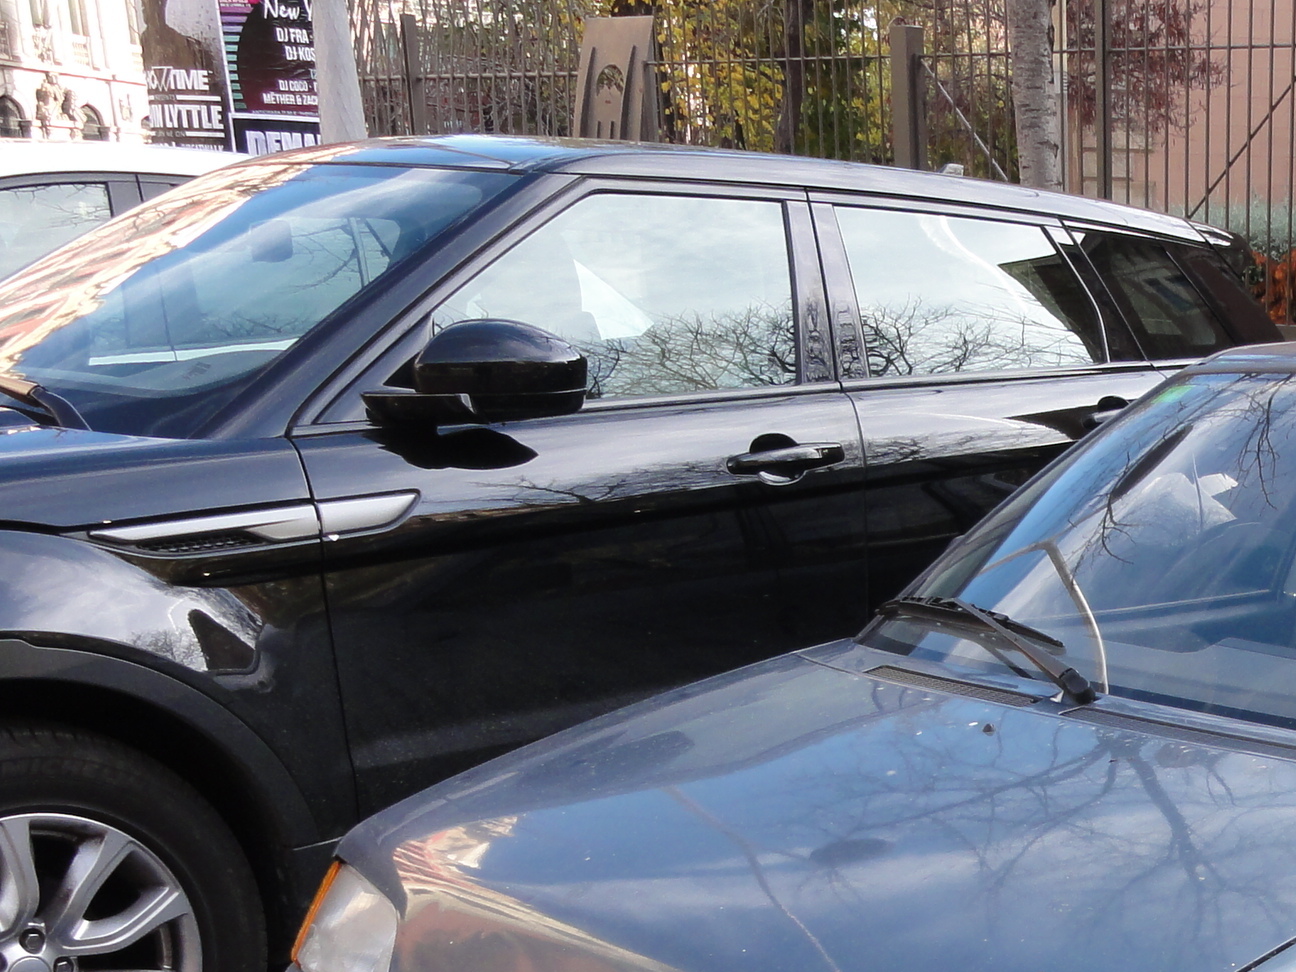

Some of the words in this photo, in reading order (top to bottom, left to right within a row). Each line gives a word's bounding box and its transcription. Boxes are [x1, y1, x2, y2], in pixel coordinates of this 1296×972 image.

[275, 27, 288, 42] DJ
[289, 28, 309, 43] FRA
[285, 46, 297, 60] DJ
[146, 66, 209, 92] OWTIME
[163, 104, 224, 130] LYTTLE
